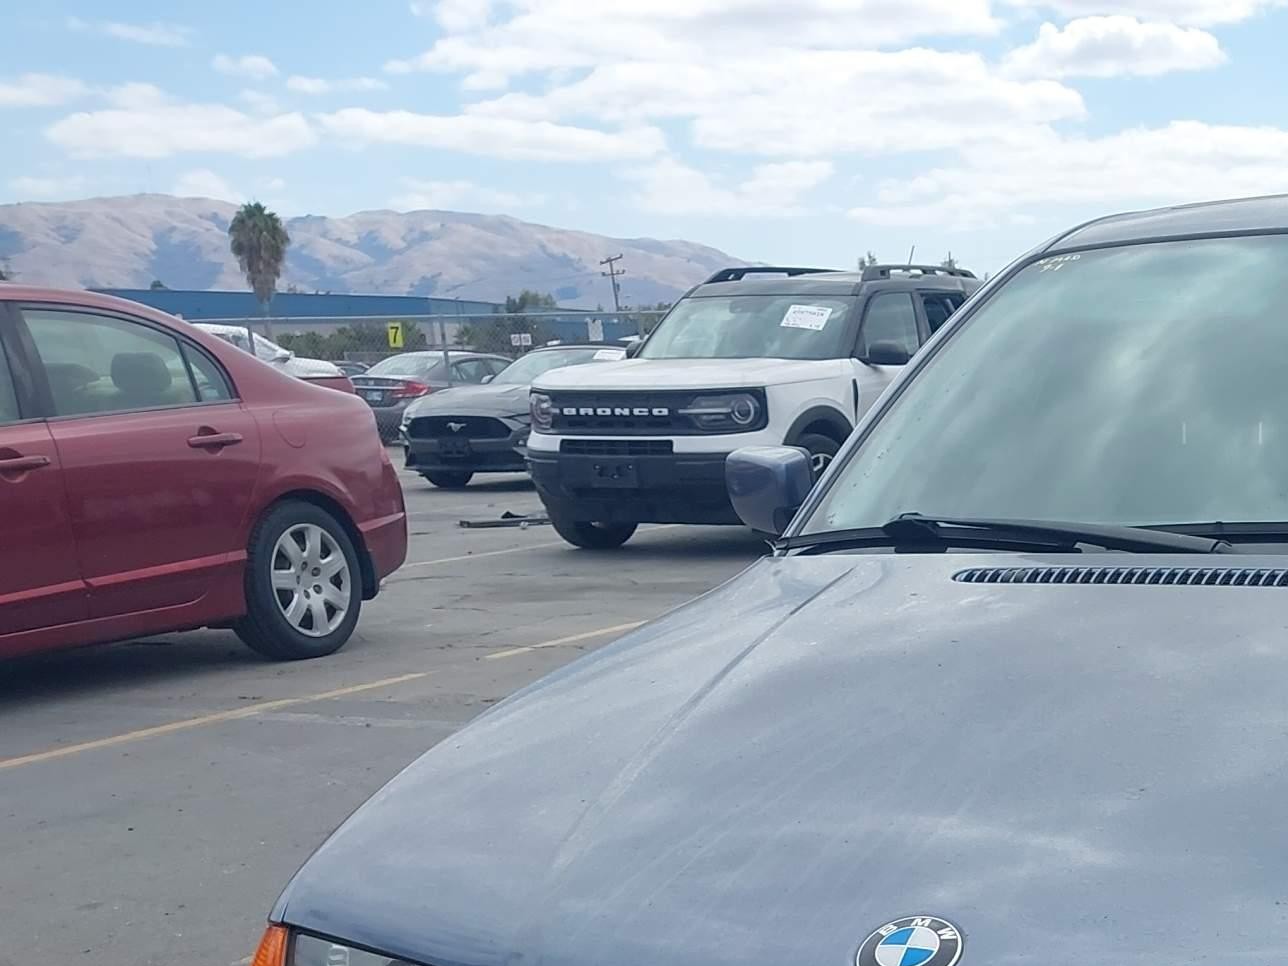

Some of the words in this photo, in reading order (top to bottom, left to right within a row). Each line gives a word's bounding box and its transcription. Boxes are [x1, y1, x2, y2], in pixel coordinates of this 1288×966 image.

[390, 326, 399, 344] 7
[563, 407, 669, 416] BRONCO
[878, 918, 958, 940] BMW
